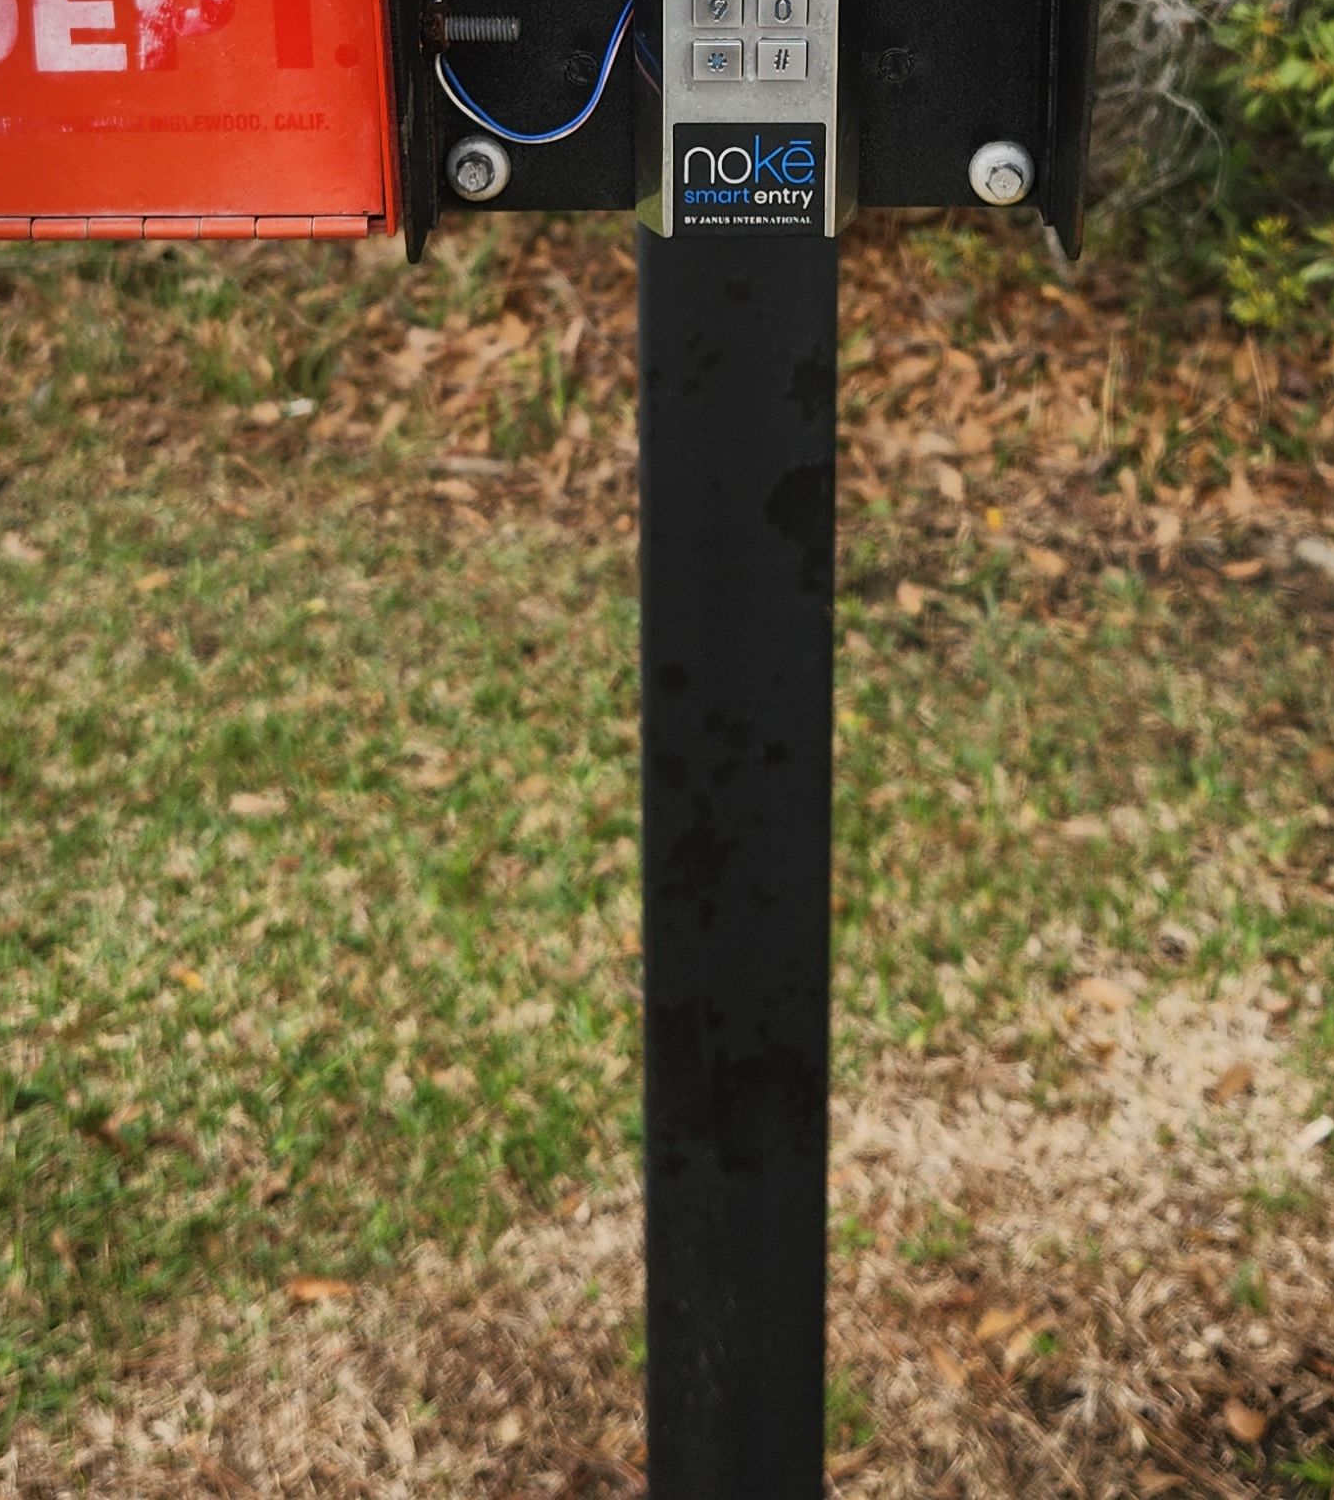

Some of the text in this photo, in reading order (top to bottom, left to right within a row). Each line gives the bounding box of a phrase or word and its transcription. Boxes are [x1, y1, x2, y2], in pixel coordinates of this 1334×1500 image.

[683, 187, 814, 209] smart entry
[684, 215, 812, 225] BY JANUS INTERNATIONAL
